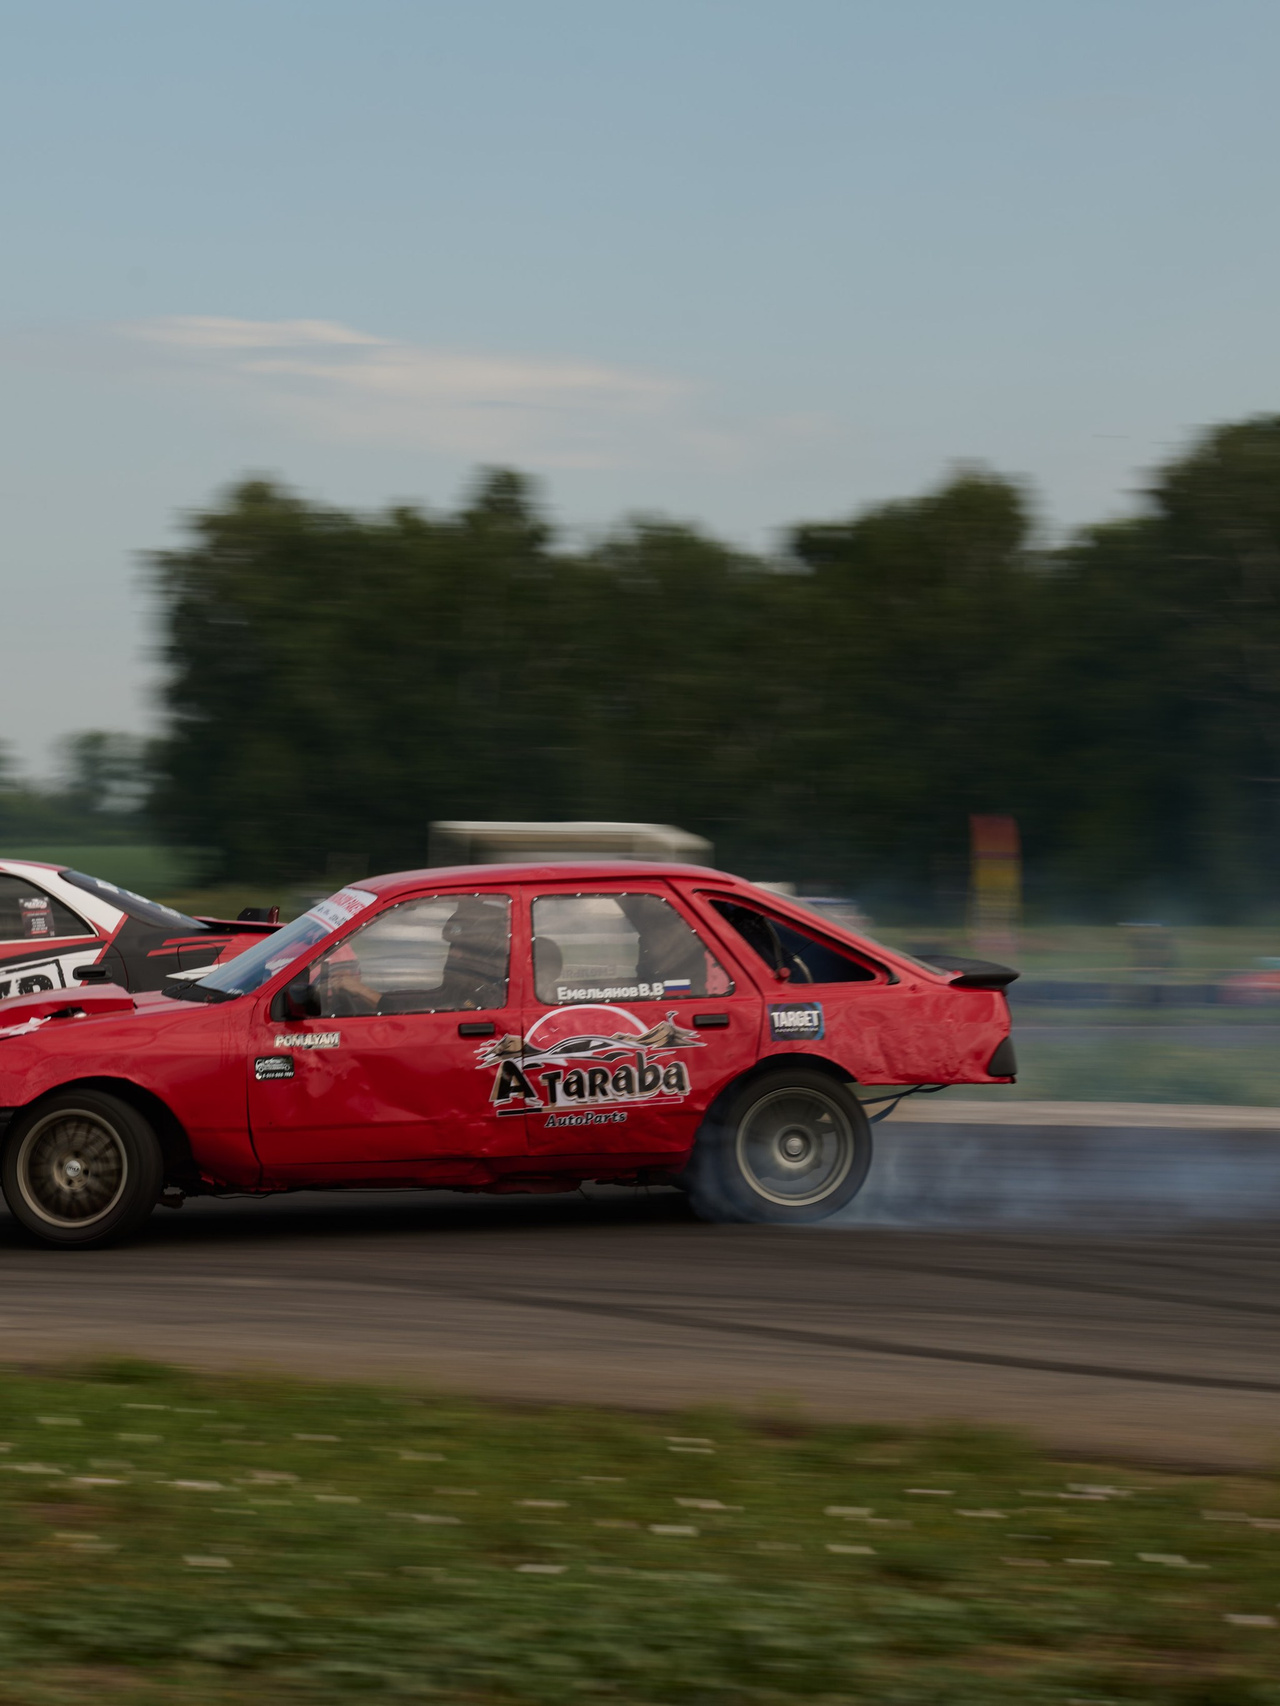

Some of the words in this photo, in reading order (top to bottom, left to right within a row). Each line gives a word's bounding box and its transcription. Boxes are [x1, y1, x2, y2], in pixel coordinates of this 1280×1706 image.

[557, 986, 638, 1000] Емельянов
[770, 1010, 820, 1028] TARGET
[544, 1110, 628, 1128] AutoParts
